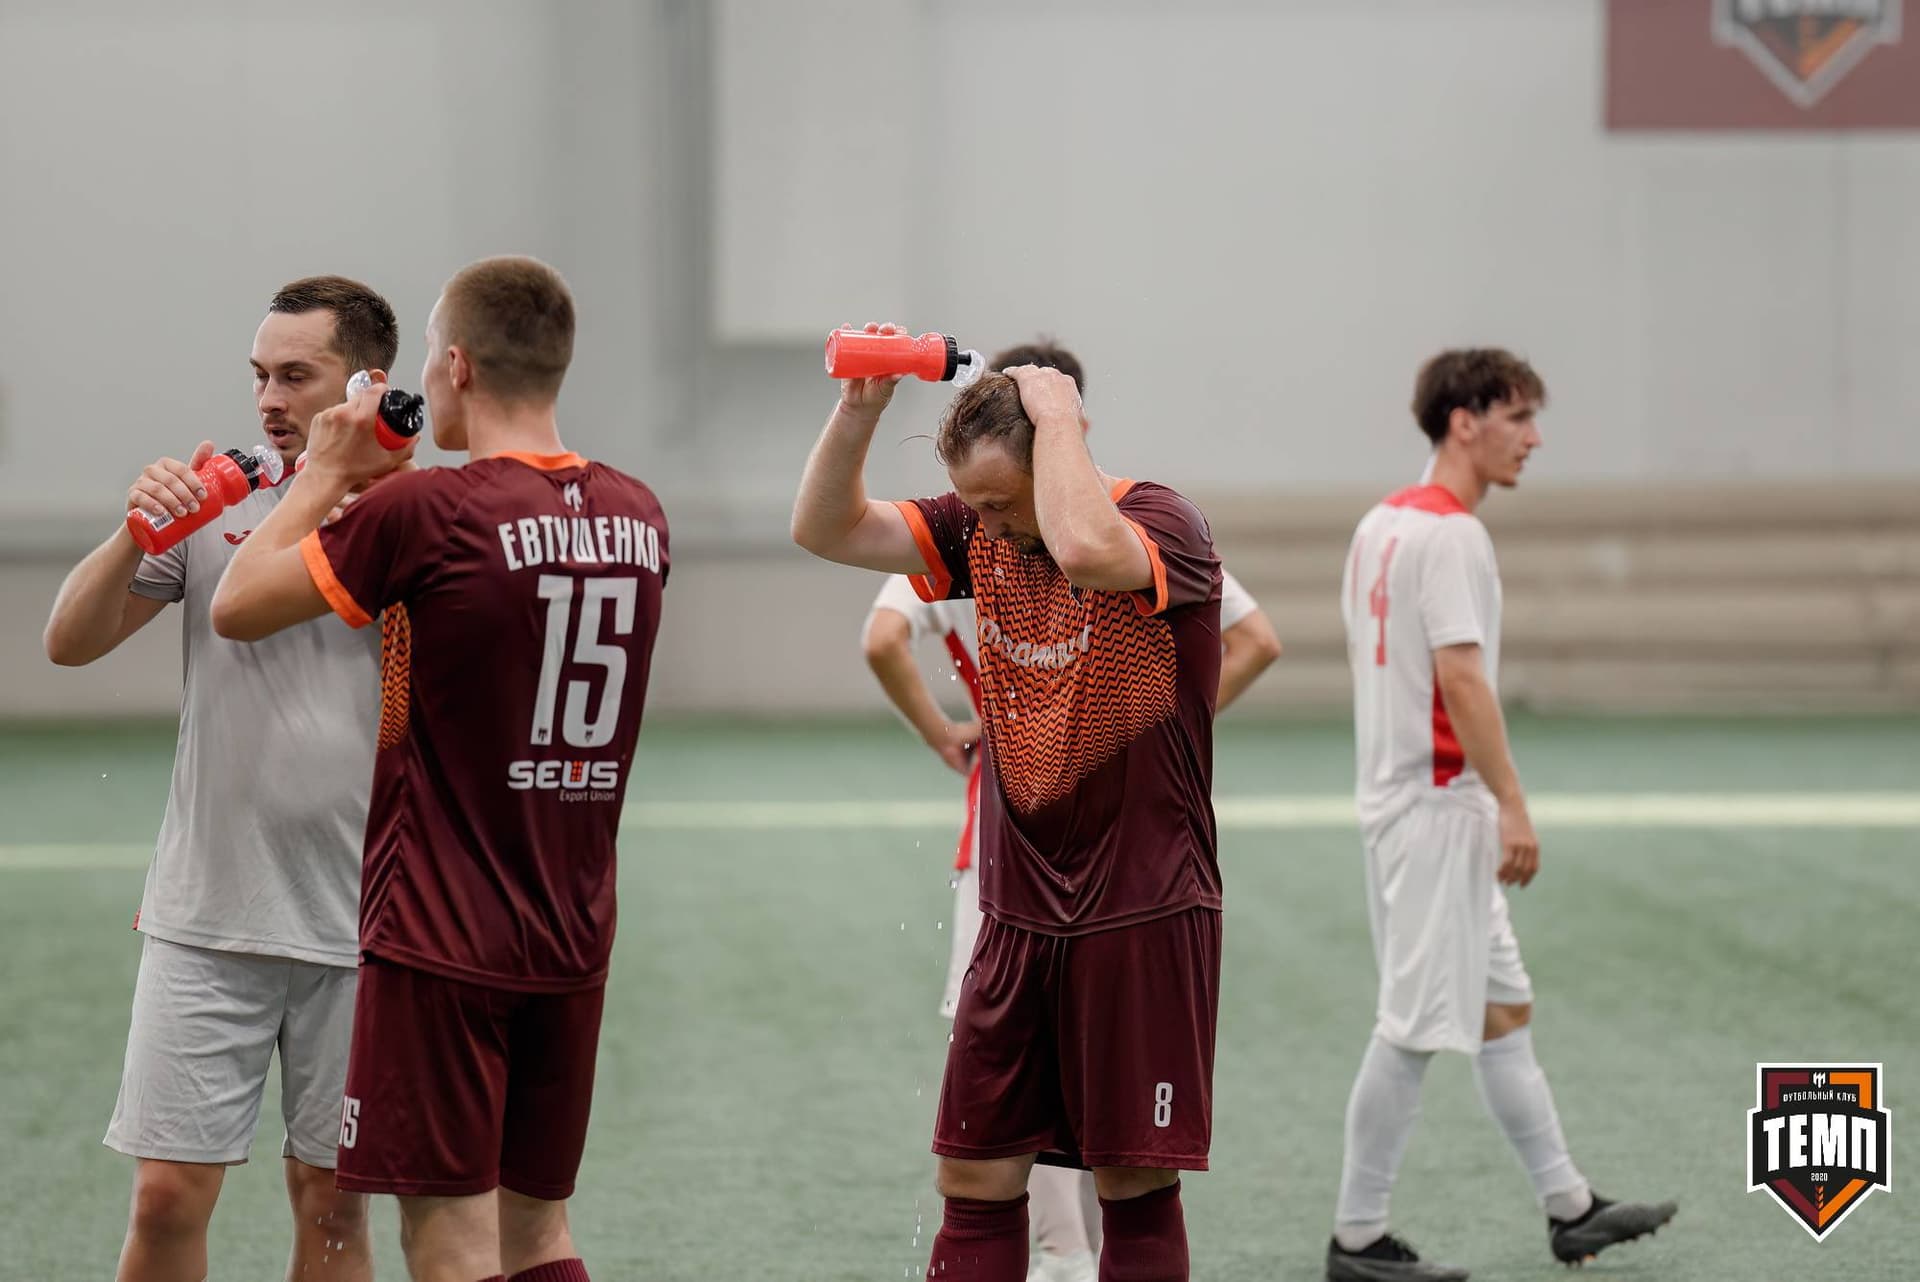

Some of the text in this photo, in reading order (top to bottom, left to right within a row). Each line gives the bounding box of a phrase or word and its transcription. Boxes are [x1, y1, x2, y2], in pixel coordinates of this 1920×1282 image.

[530, 574, 638, 748] 15
[507, 760, 619, 789] SEUS
[559, 789, 616, 802] Export Union
[1154, 1082, 1173, 1128] 8
